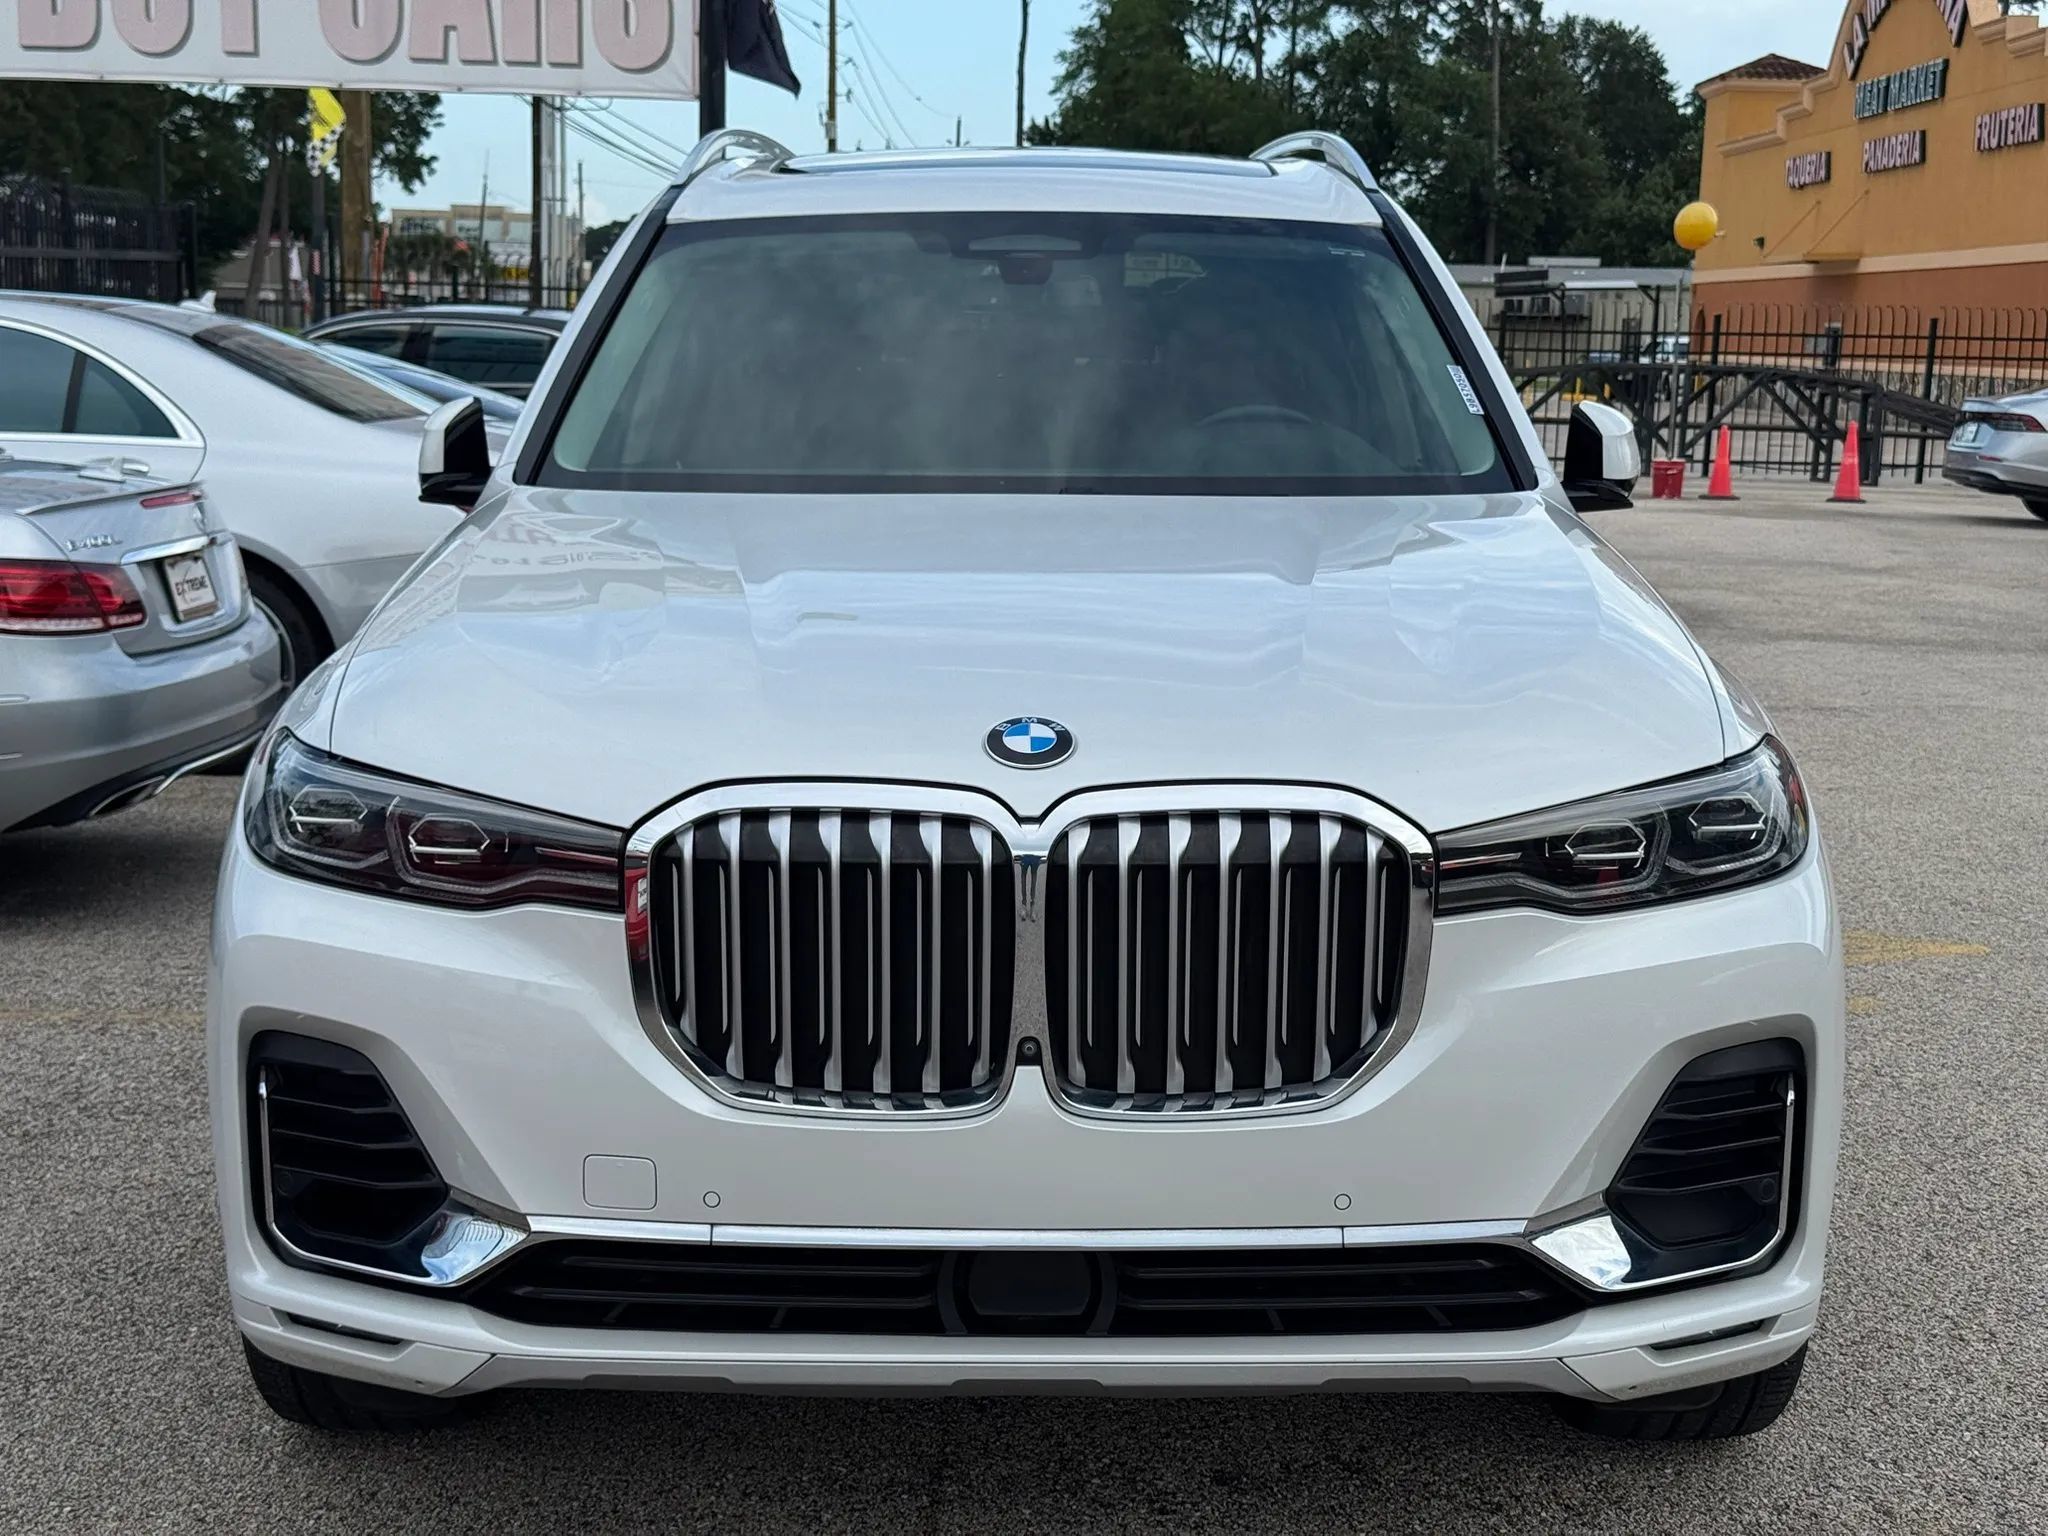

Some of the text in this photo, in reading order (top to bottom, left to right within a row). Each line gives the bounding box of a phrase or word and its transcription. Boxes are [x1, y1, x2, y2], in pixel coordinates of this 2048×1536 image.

[1855, 57, 1947, 119] MEAT MARKET
[1975, 103, 2040, 152] FRUTERIA
[1785, 151, 1827, 189] TAQUERIA
[1862, 129, 1922, 174] PANADERIA
[994, 716, 1066, 731] BMW
